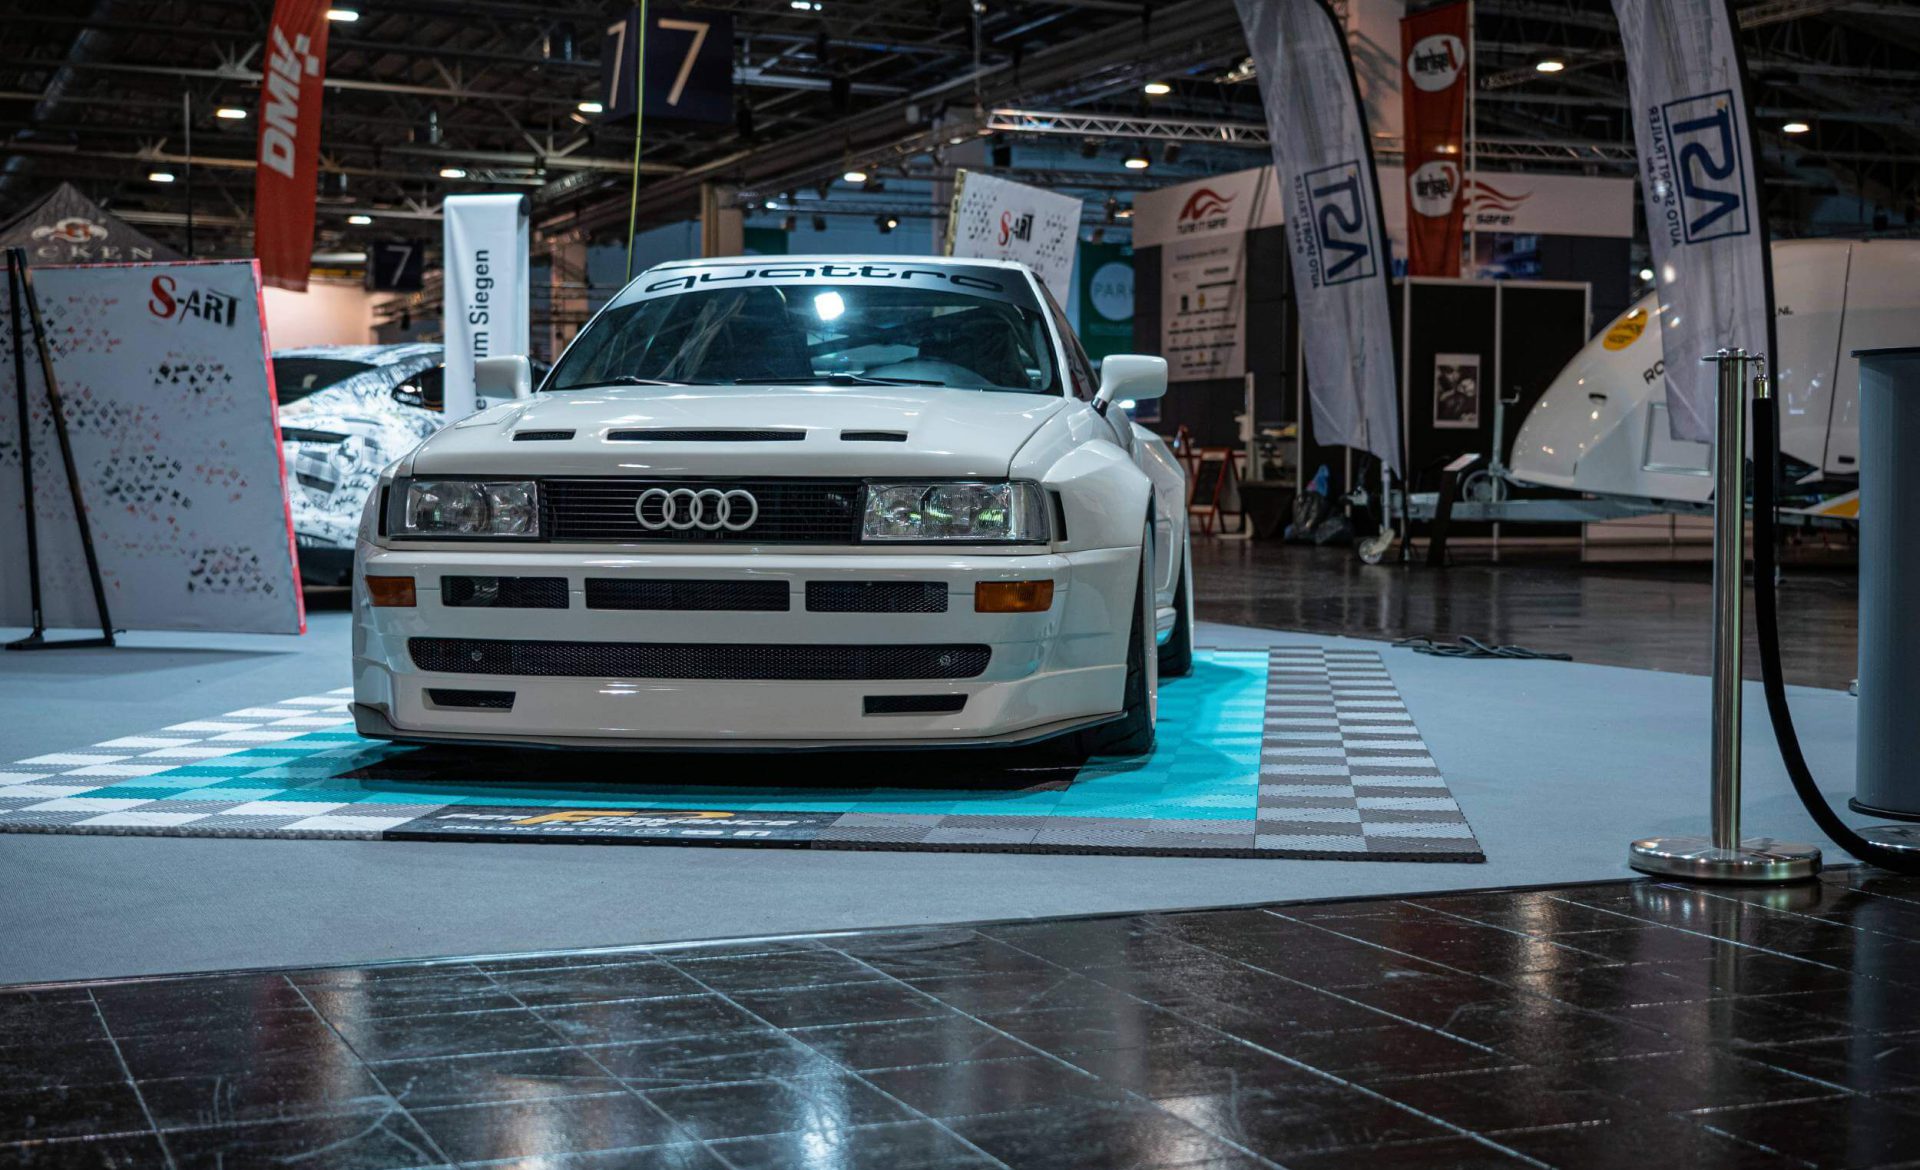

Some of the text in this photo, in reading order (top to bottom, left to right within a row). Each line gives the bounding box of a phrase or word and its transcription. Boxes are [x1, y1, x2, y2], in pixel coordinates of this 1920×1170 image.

[385, 244, 414, 287] 7
[469, 249, 495, 325] Siegen
[645, 265, 1004, 294] quattro
[148, 274, 242, 328] S-ART
